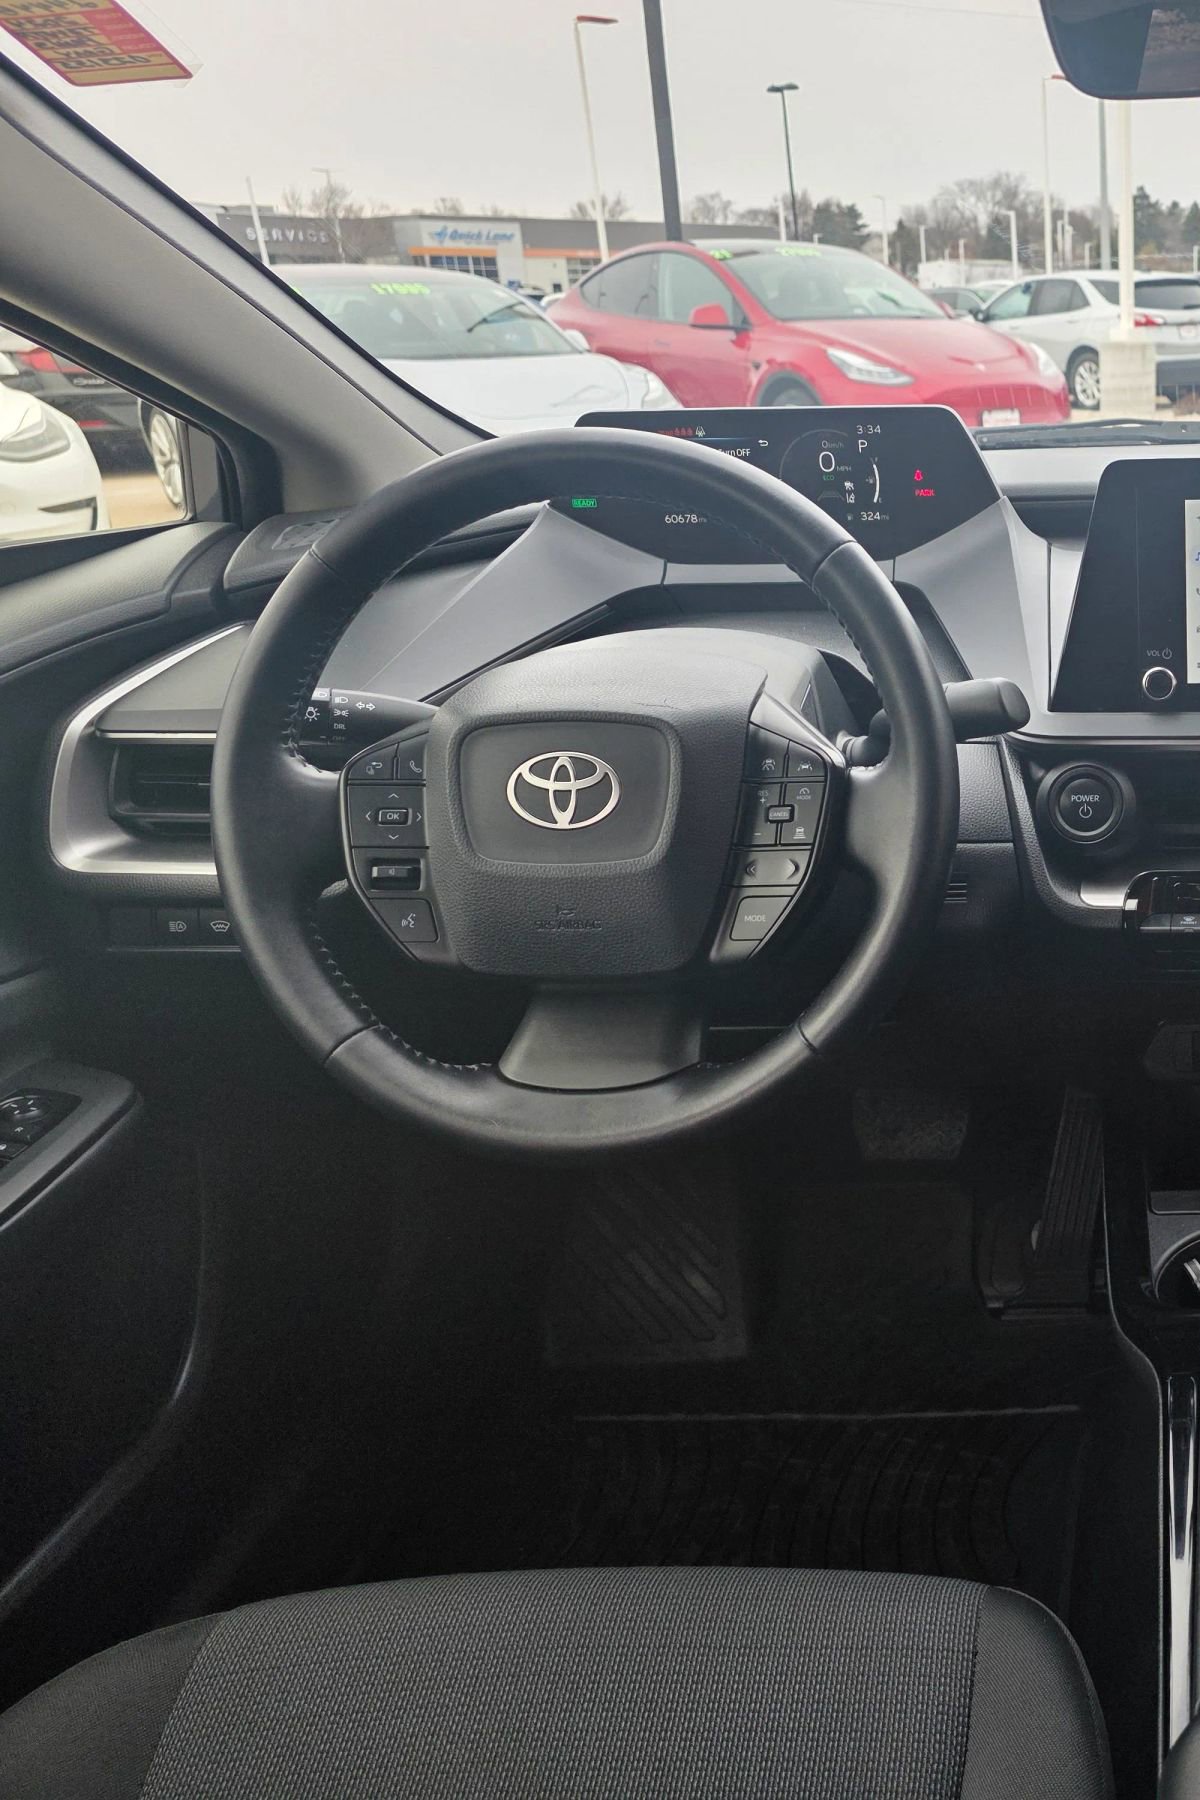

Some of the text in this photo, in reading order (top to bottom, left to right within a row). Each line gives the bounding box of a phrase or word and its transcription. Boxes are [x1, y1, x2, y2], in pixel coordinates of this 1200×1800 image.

[857, 425, 880, 434] 3:34
[859, 440, 867, 453] P
[737, 449, 751, 457] OFF
[819, 451, 836, 472] 0
[573, 499, 596, 507] READY
[665, 514, 698, 524] 60678
[861, 512, 880, 521] 324
[1071, 794, 1100, 802] POWER
[386, 812, 400, 820] OK
[744, 914, 767, 922] MODE
